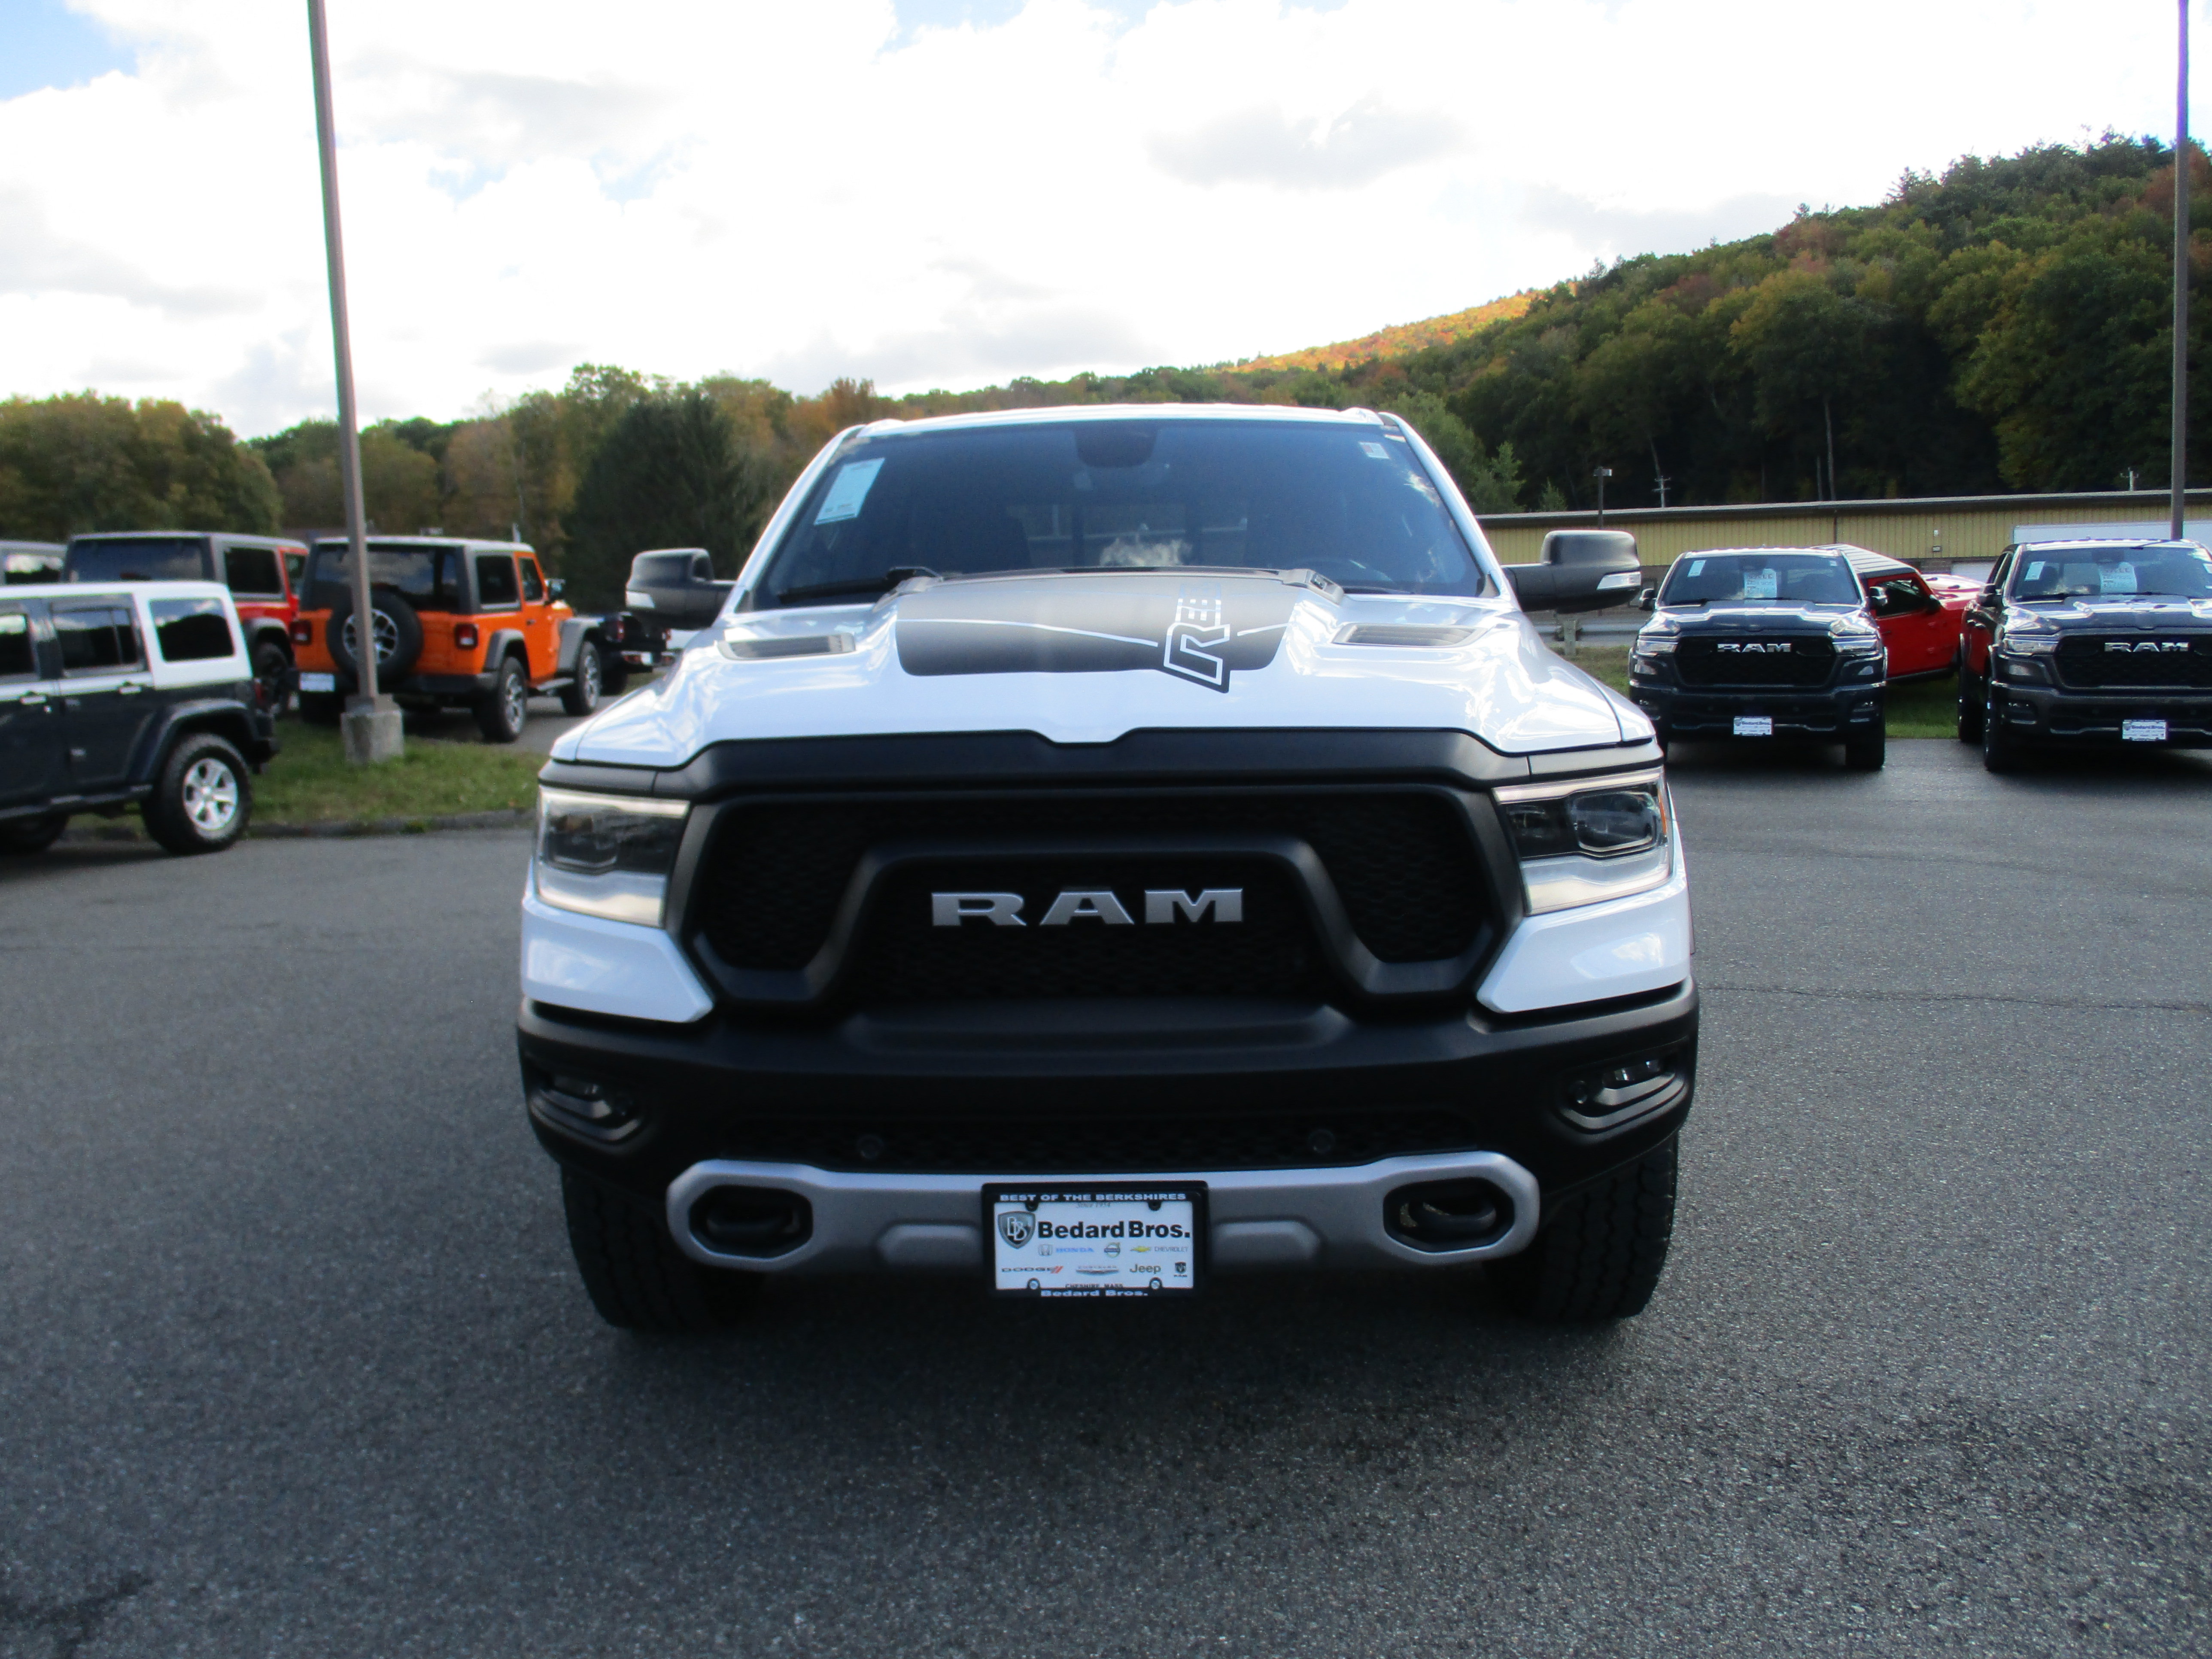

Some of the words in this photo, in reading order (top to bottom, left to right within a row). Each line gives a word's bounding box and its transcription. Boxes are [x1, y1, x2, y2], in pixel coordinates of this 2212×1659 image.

[1717, 644, 1791, 653] RAM
[2105, 642, 2189, 652] RAM
[931, 888, 1243, 926] RAM
[1038, 1221, 1124, 1238] Bedard
[1128, 1220, 1191, 1238] Bros.
[1130, 1264, 1161, 1274] Jeep
